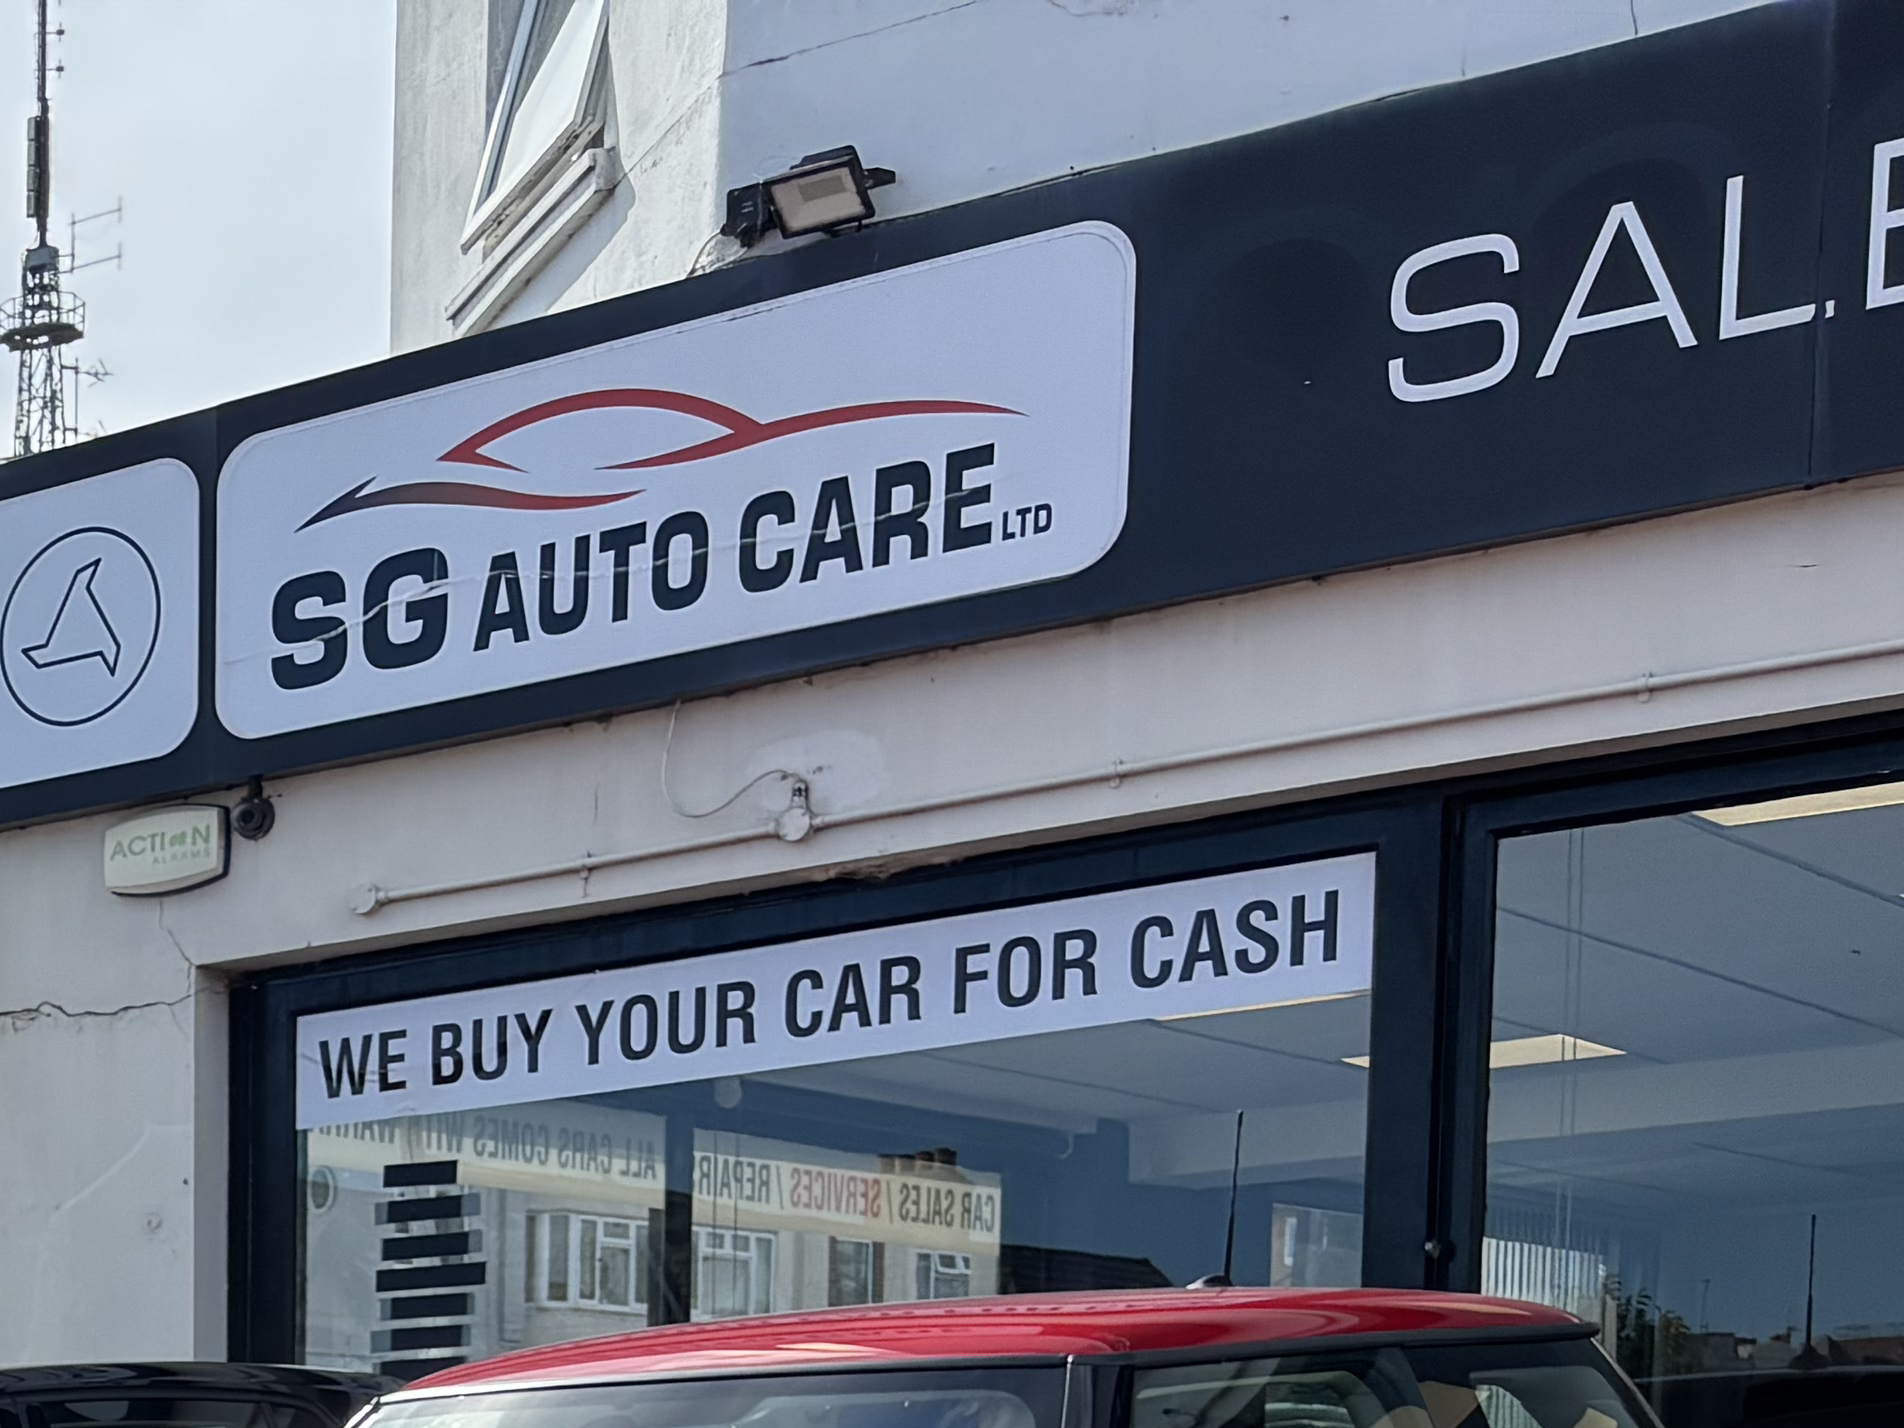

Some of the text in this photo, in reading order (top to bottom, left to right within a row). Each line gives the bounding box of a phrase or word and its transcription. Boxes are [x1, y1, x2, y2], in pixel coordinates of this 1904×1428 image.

[271, 442, 1053, 691] SG AUTO CARE LTD
[319, 888, 1340, 1099] WE BUY YOUR CAR FOR CASH
